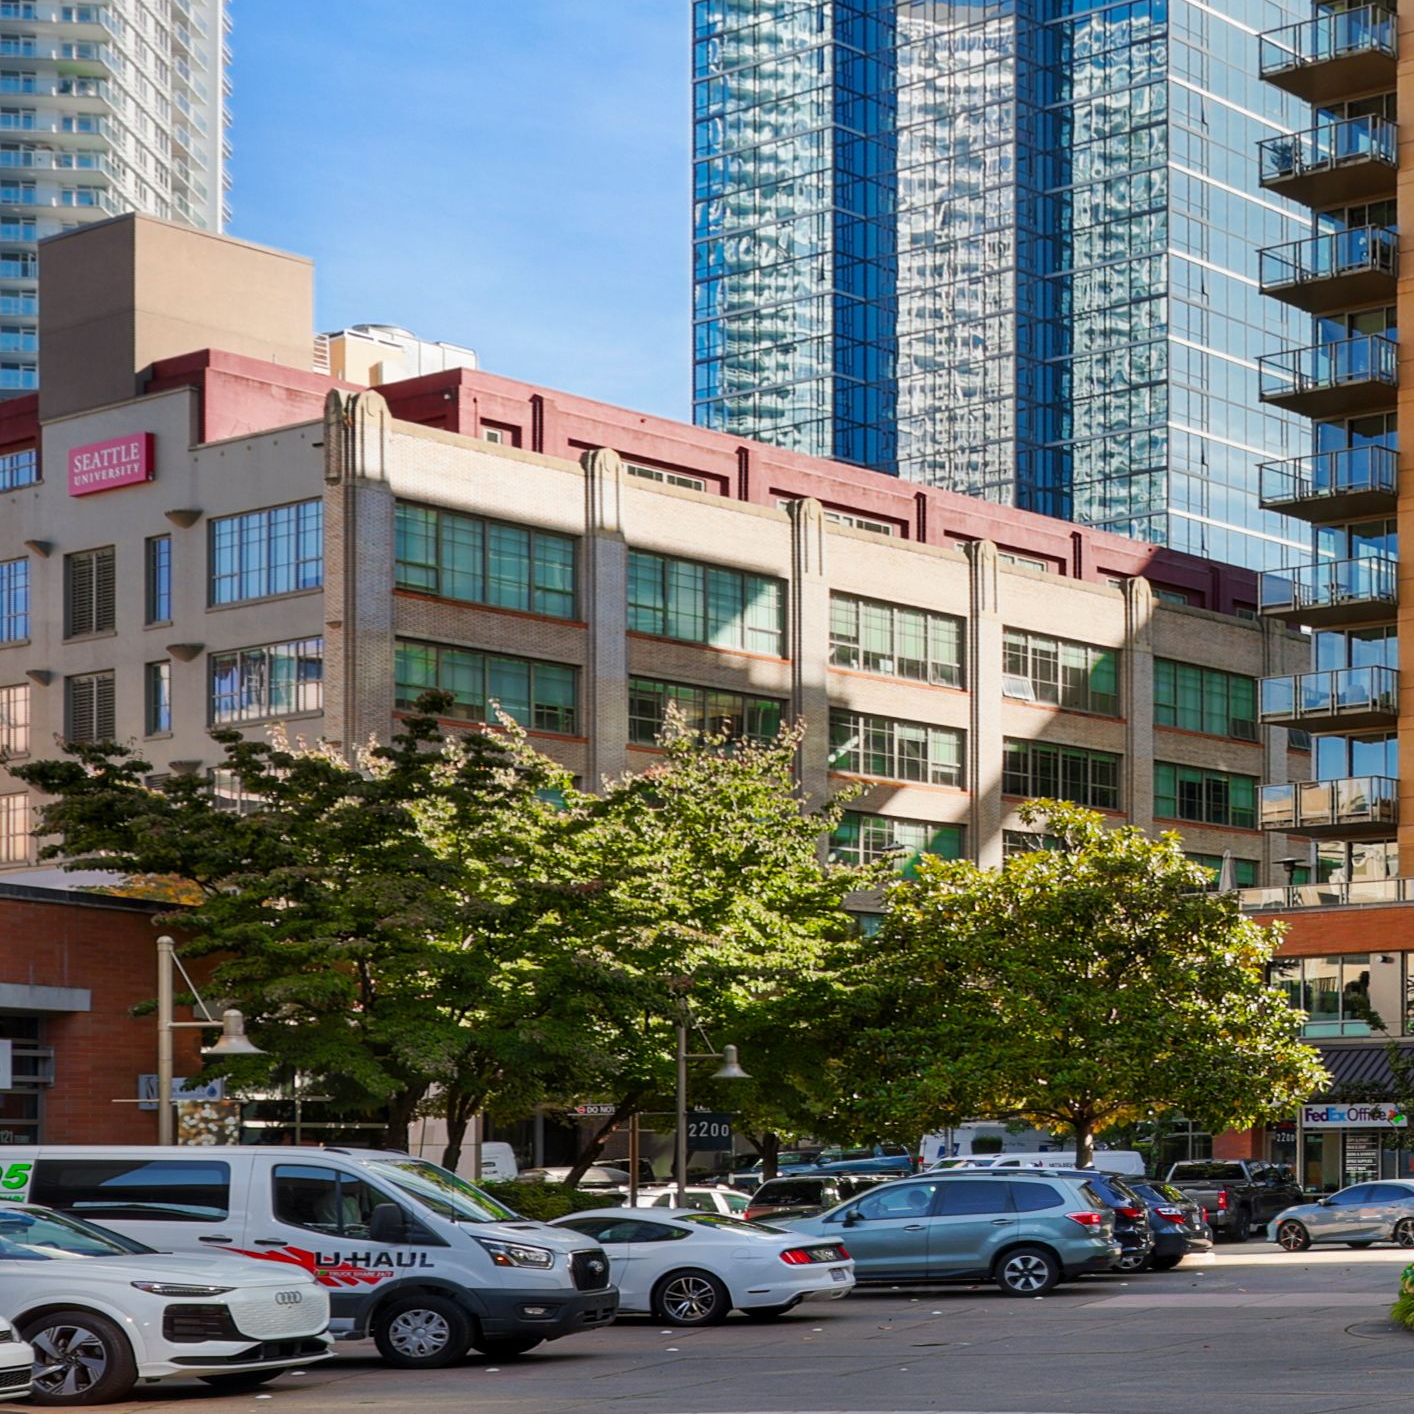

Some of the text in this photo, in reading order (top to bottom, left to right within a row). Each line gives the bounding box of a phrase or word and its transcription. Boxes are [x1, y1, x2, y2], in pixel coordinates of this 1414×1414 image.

[73, 442, 140, 473] SEATTLE
[73, 463, 140, 487] UNIVERSITY
[586, 1106, 599, 1114] DO
[1304, 1107, 1345, 1122] FedEx
[688, 1121, 729, 1137] 2200
[315, 1252, 434, 1268] U-HAUL
